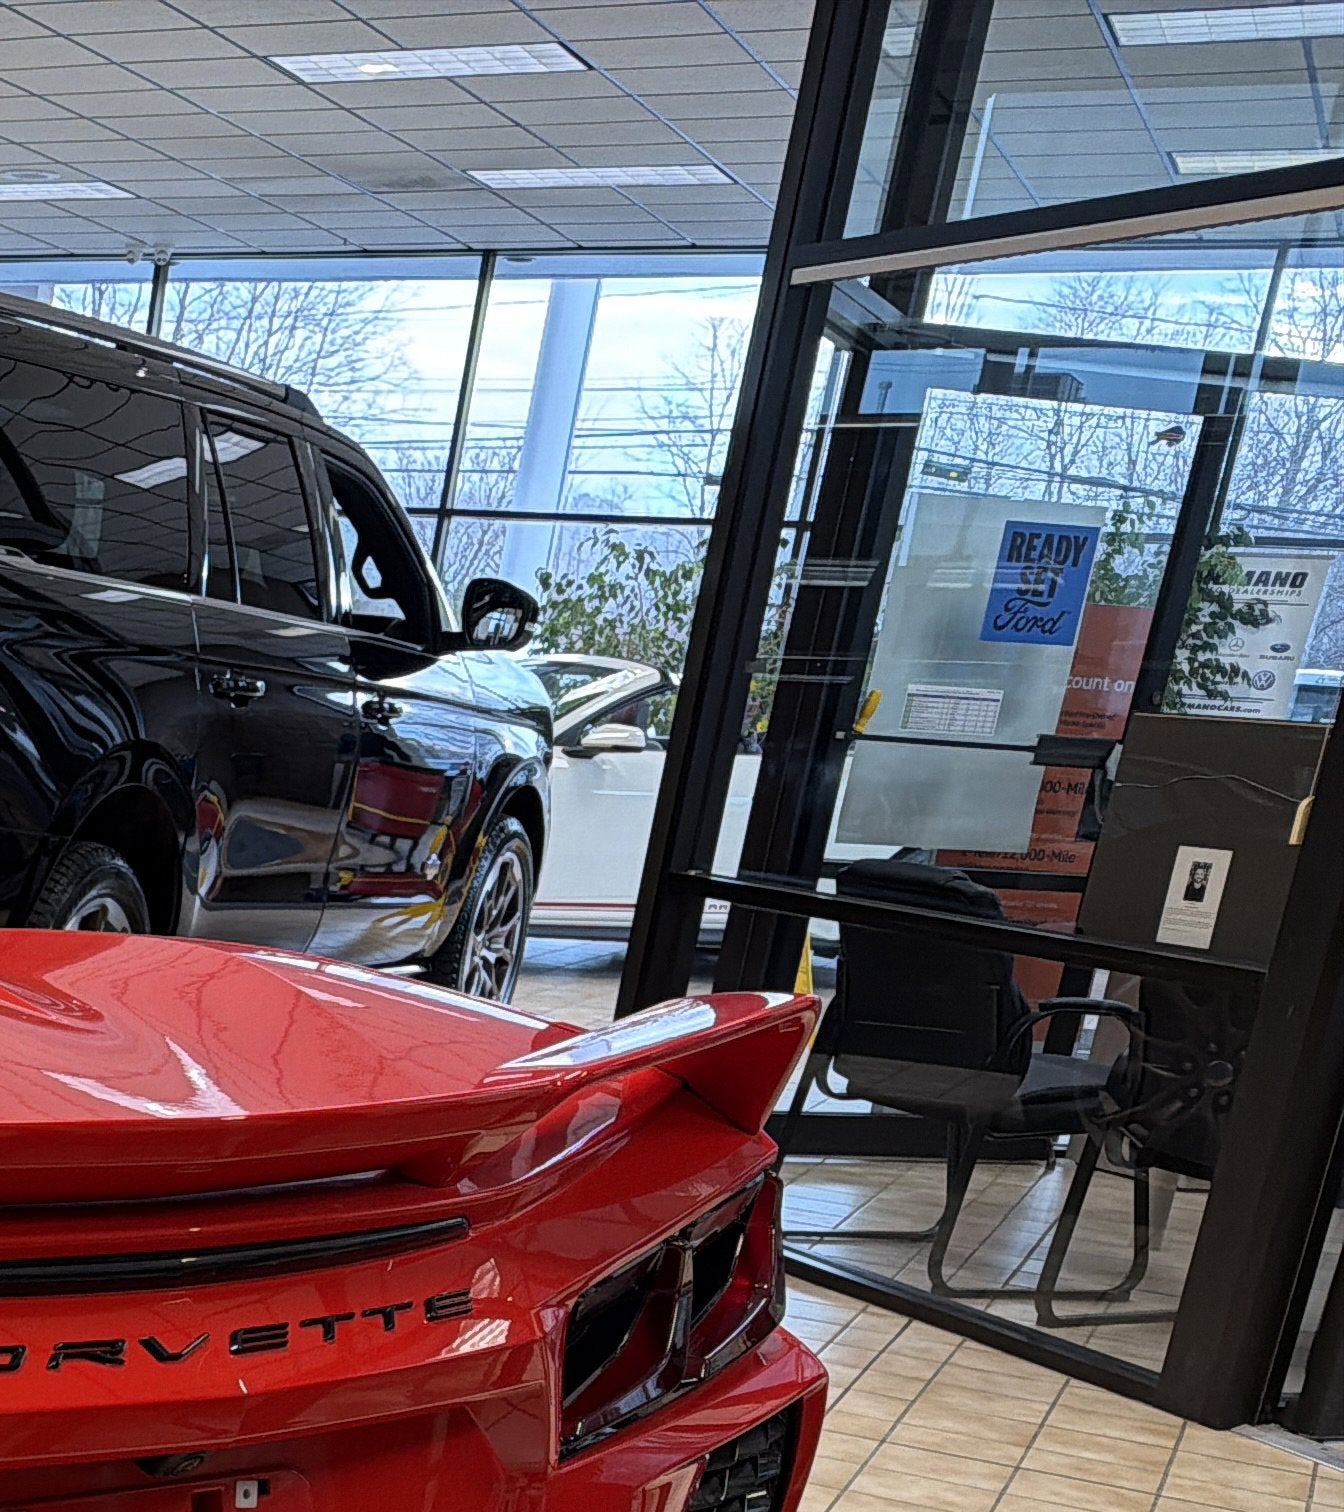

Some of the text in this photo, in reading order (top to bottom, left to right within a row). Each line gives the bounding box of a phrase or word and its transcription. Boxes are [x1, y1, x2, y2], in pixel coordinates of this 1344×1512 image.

[1007, 530, 1089, 568] READY
[1016, 565, 1064, 599] SET
[1229, 587, 1302, 597] DEALERSHIPS
[993, 597, 1071, 636] Ford
[1258, 654, 1296, 662] SUBARU
[1114, 680, 1135, 694] on
